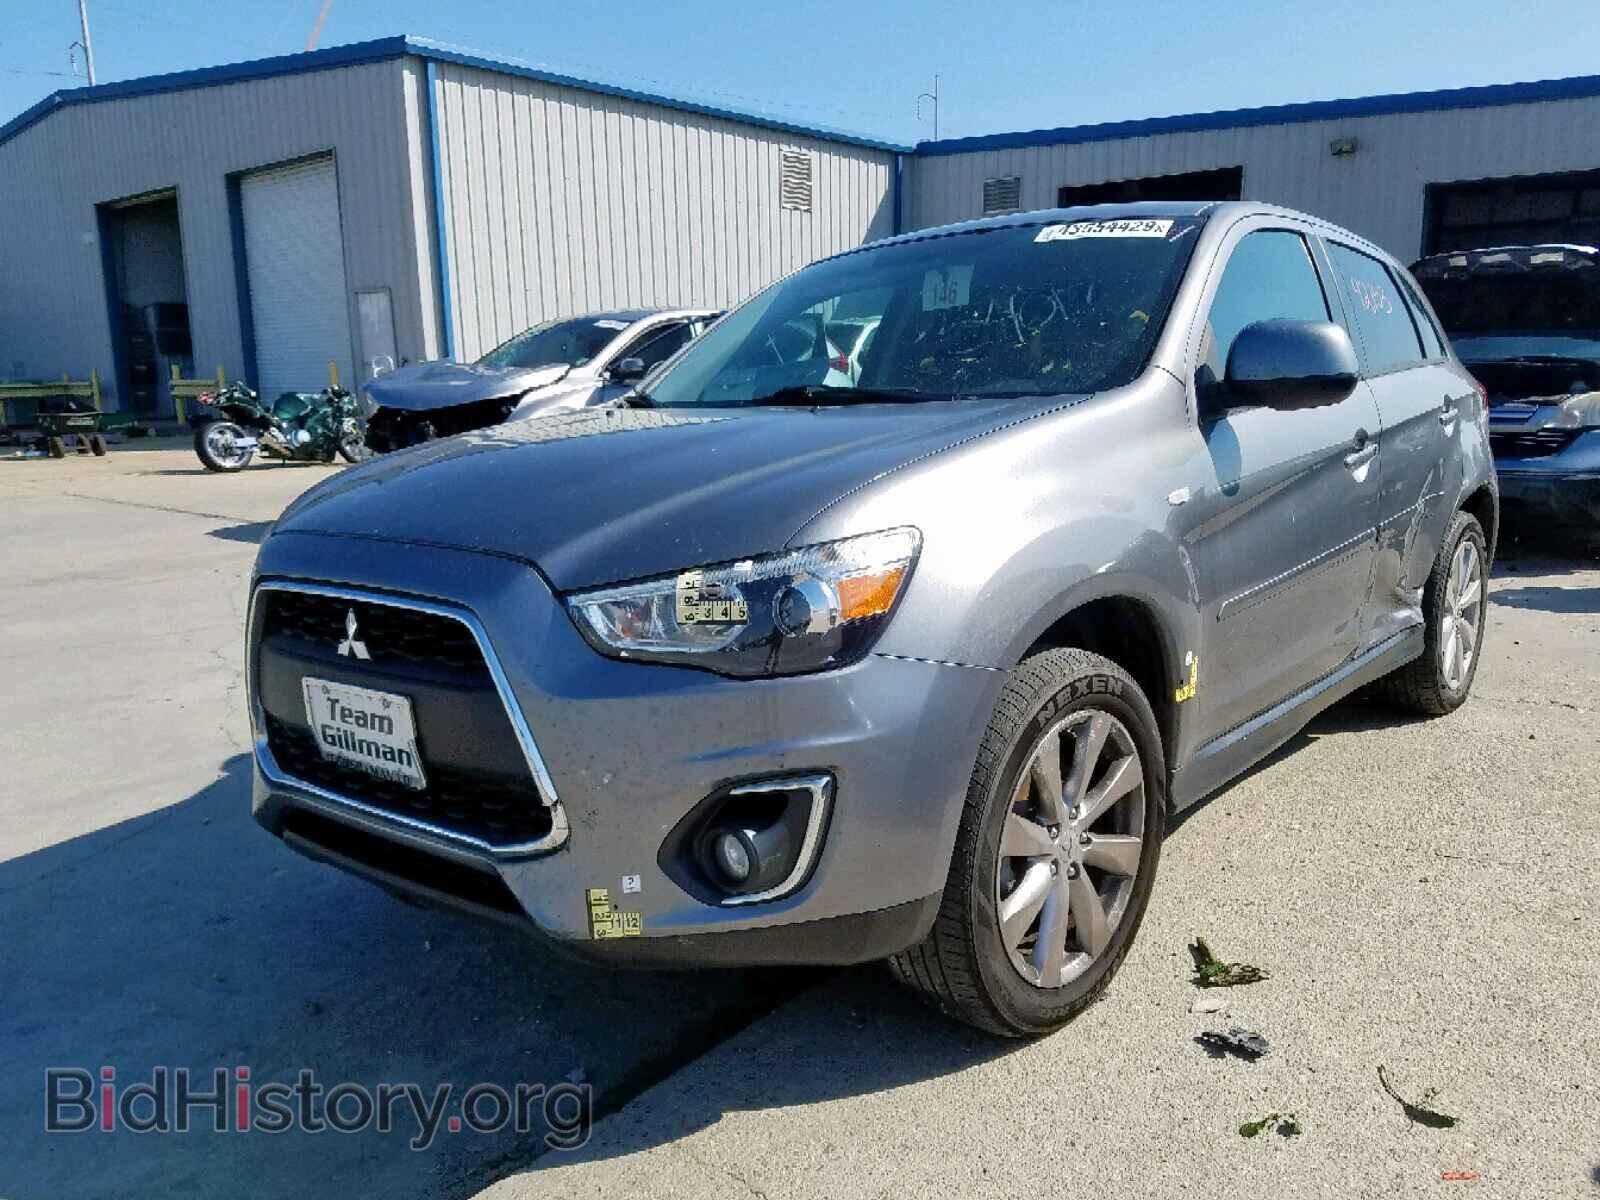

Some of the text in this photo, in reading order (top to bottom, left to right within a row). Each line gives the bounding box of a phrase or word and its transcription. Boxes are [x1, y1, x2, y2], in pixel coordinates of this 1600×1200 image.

[721, 607, 729, 618] 4
[738, 607, 746, 618] 5
[326, 697, 394, 735] Team
[320, 724, 413, 768] Gillman
[626, 918, 639, 928] 12
